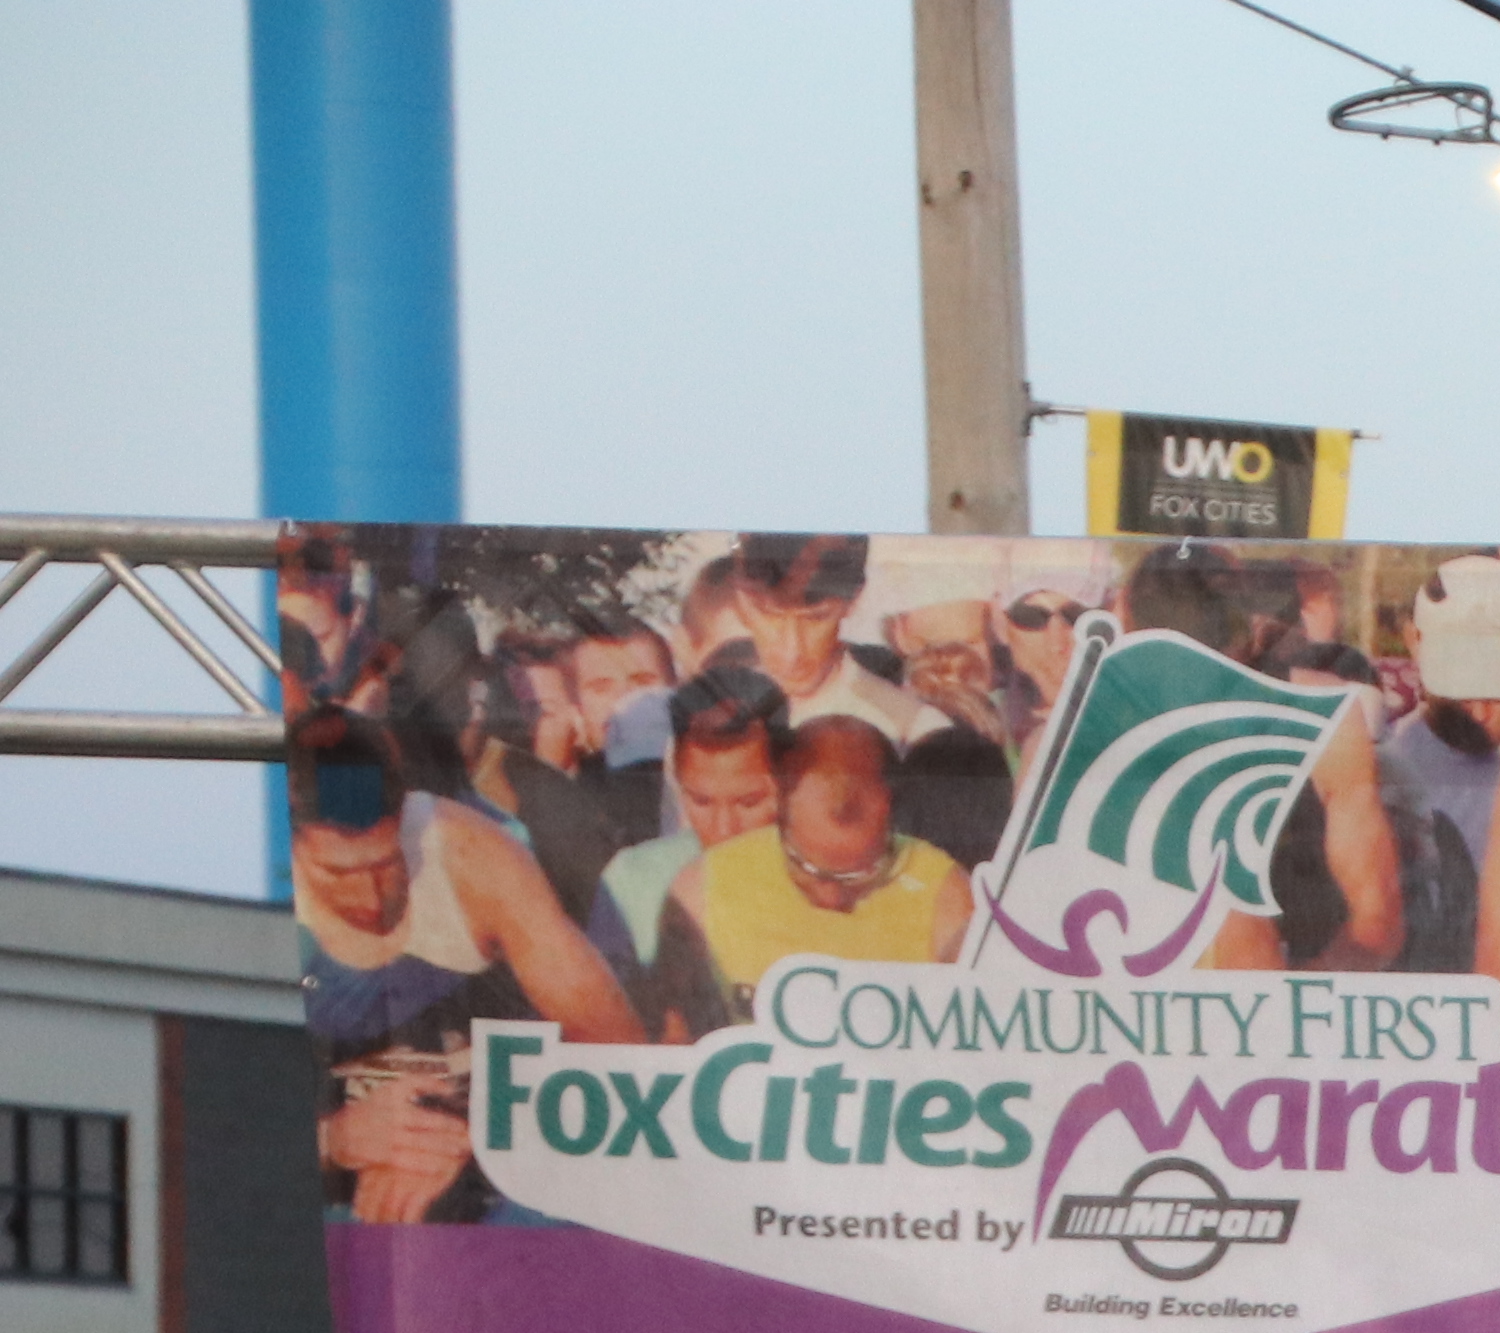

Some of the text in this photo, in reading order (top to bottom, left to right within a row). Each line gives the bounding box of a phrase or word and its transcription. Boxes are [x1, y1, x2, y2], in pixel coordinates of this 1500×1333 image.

[1163, 435, 1273, 483] UWO
[1151, 494, 1278, 526] FOX CITIES
[772, 966, 1490, 1061] COMMUNITY FIRST
[753, 1206, 1025, 1251] Presented by
[1122, 1201, 1285, 1239] Miron
[1045, 1293, 1299, 1319] Building Excellence
